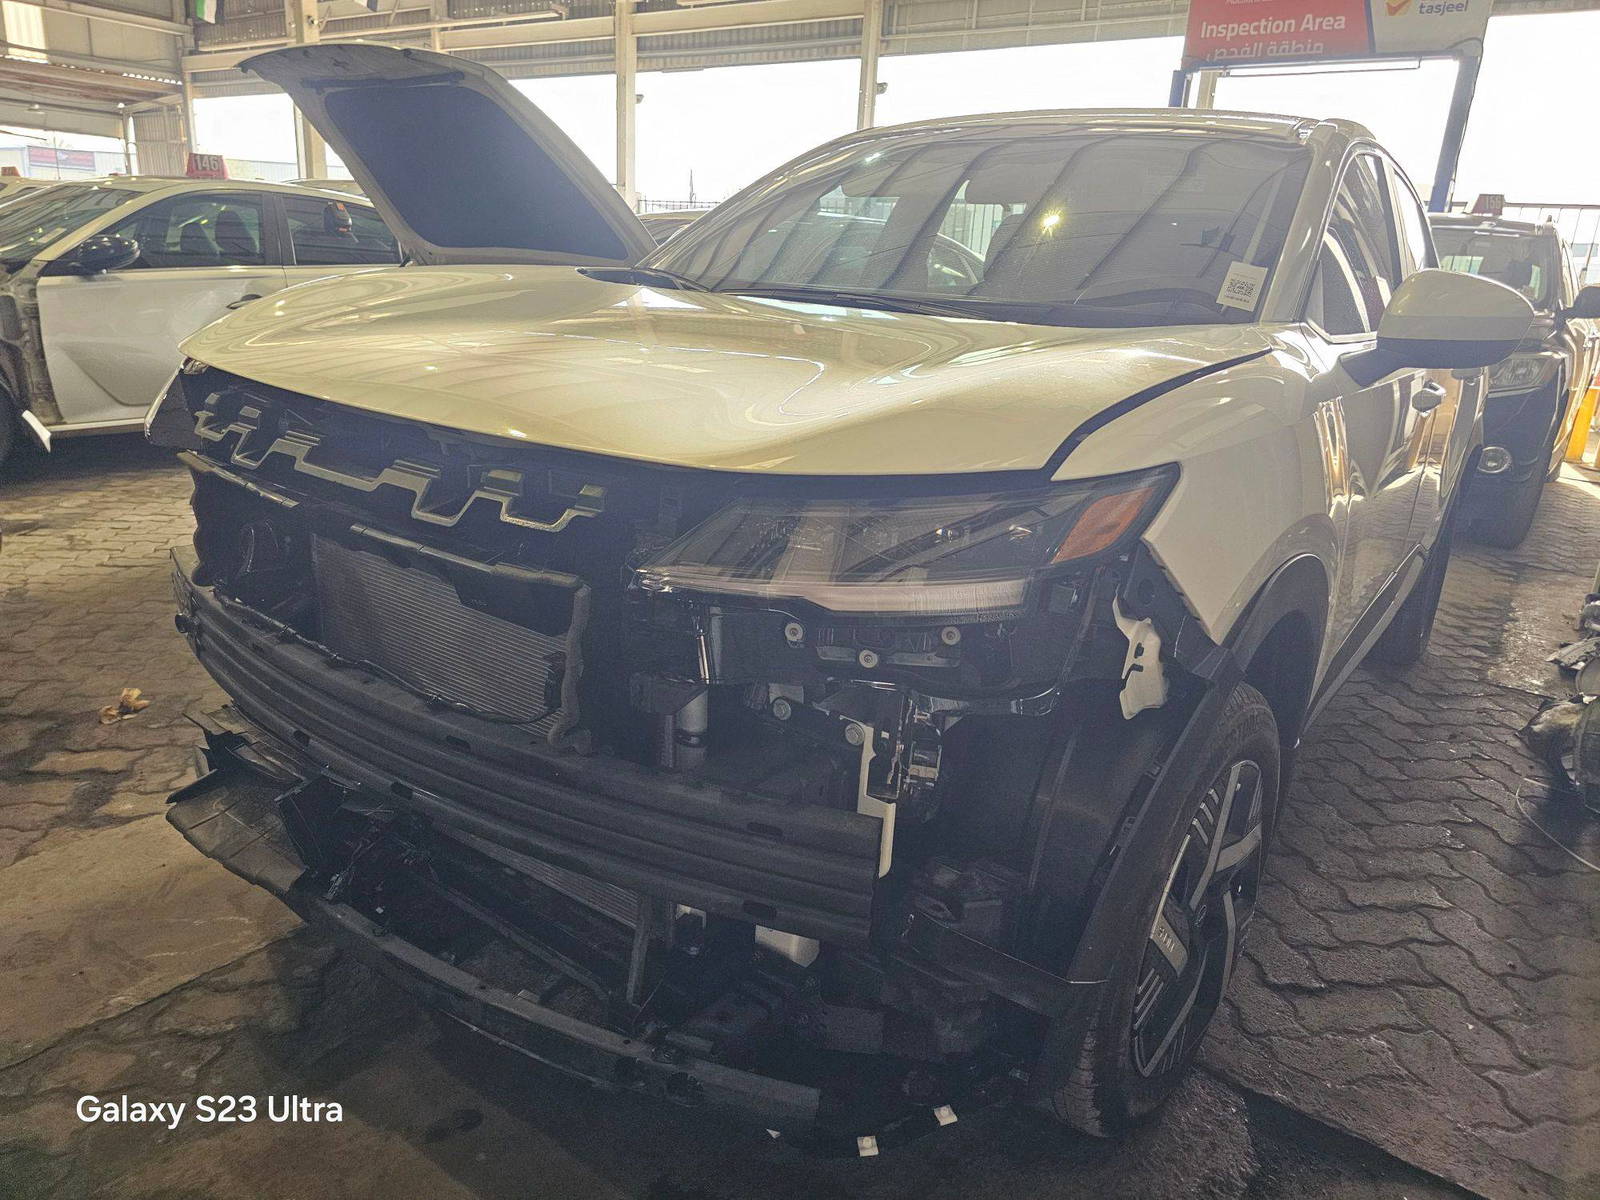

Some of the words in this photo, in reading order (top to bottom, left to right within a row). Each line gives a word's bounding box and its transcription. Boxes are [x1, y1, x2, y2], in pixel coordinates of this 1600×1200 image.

[1418, 0, 1469, 16] tasjeel
[1200, 16, 1296, 42] Inspection
[1300, 13, 1346, 31] Area
[1267, 39, 1324, 57] منطقة
[195, 154, 218, 171] 146
